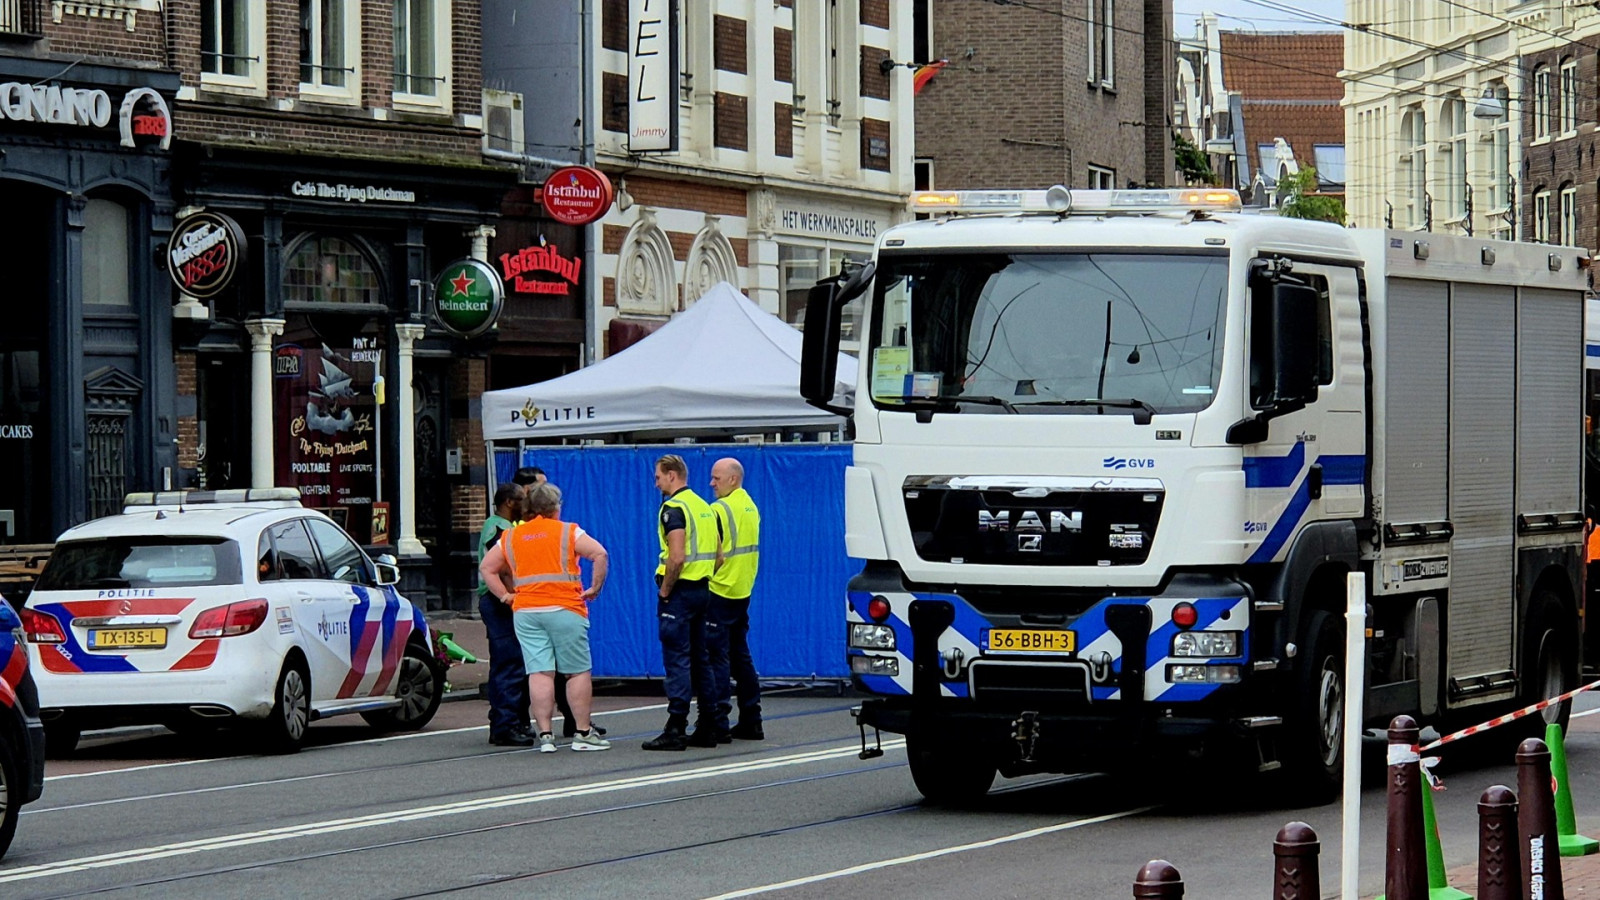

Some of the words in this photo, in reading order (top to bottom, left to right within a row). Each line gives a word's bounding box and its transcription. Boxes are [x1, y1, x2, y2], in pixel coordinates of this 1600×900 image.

[635, 0, 662, 102] EL
[0, 82, 111, 128] GNANO
[632, 127, 668, 138] Jimmy
[316, 182, 336, 198] The
[336, 184, 366, 203] Flying
[366, 185, 416, 203] Dutchman
[548, 184, 600, 199] Istanbul
[553, 197, 594, 208] Restaurant
[782, 210, 798, 229] HET
[800, 212, 877, 238] WERKMANSPALEIS
[183, 243, 227, 288] 1882
[499, 244, 582, 286] Istanbul
[514, 276, 569, 296] Restaurant
[438, 299, 489, 311] Heineken
[300, 437, 312, 455] The
[313, 441, 334, 458] Flying
[334, 440, 369, 455] Dutchman
[291, 462, 331, 473] POOLTABLE
[339, 464, 352, 472] LIVE
[352, 464, 373, 472] SPORTS
[1128, 458, 1155, 468] GVB
[299, 485, 332, 495] NIGHTBAR
[978, 510, 1083, 533] MAN
[1255, 522, 1268, 532] GVB
[98, 589, 156, 599] POLITIE
[101, 631, 157, 644] TX-135-L
[993, 632, 1069, 649] 56-BBH-3
